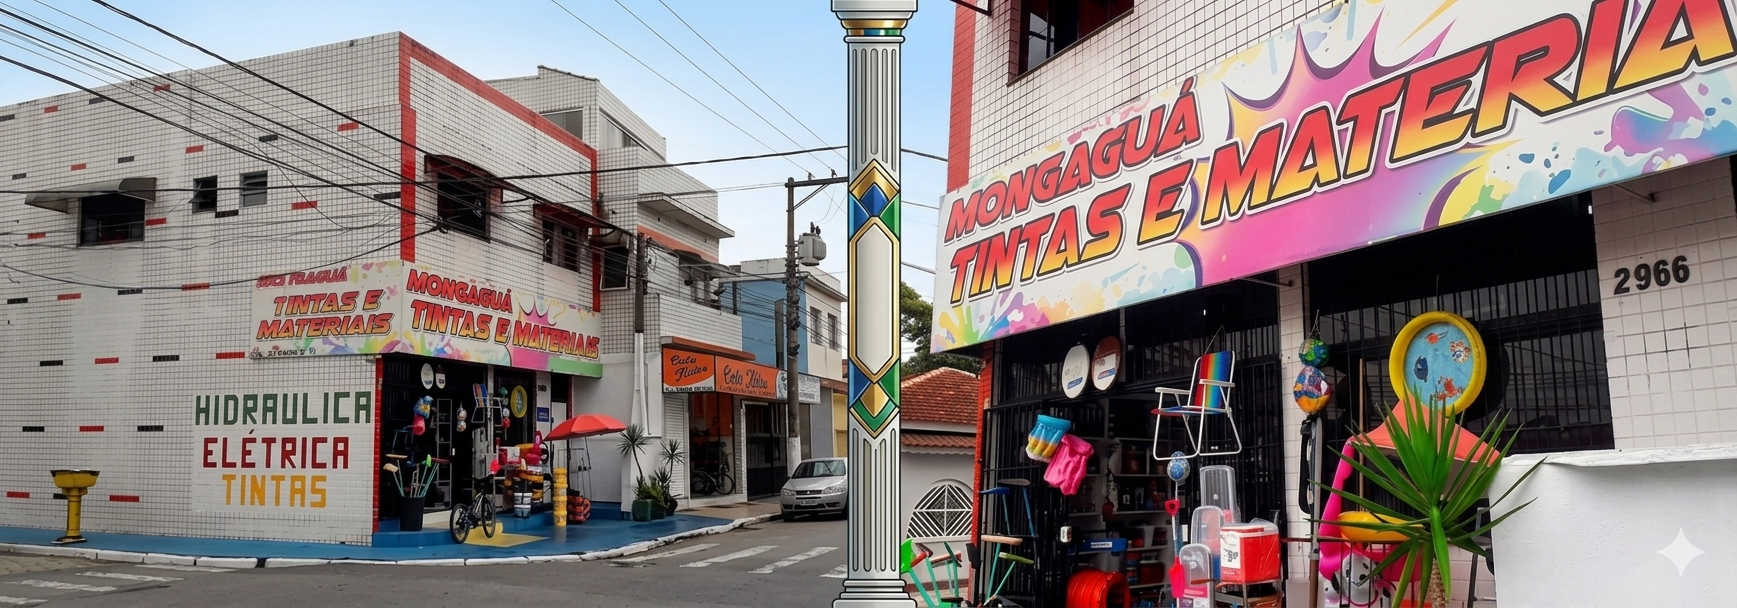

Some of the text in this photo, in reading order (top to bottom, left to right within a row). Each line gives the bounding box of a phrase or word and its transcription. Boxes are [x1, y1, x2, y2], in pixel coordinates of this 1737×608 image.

[944, 76, 1201, 243] MONGAGUÁ
[950, 183, 1132, 304] TINTAS
[1137, 159, 1194, 246] E
[406, 268, 513, 314] MONGAGUÁ
[1613, 254, 1690, 295] 2966
[273, 289, 384, 316] TINTAS E
[256, 312, 394, 340] MATERIAIS
[410, 299, 600, 360] TINTAS E MATERIAIS
[195, 391, 371, 425] HIDRAULICA
[203, 429, 349, 469] ELÉTRICA
[222, 474, 327, 508] TINTAS
